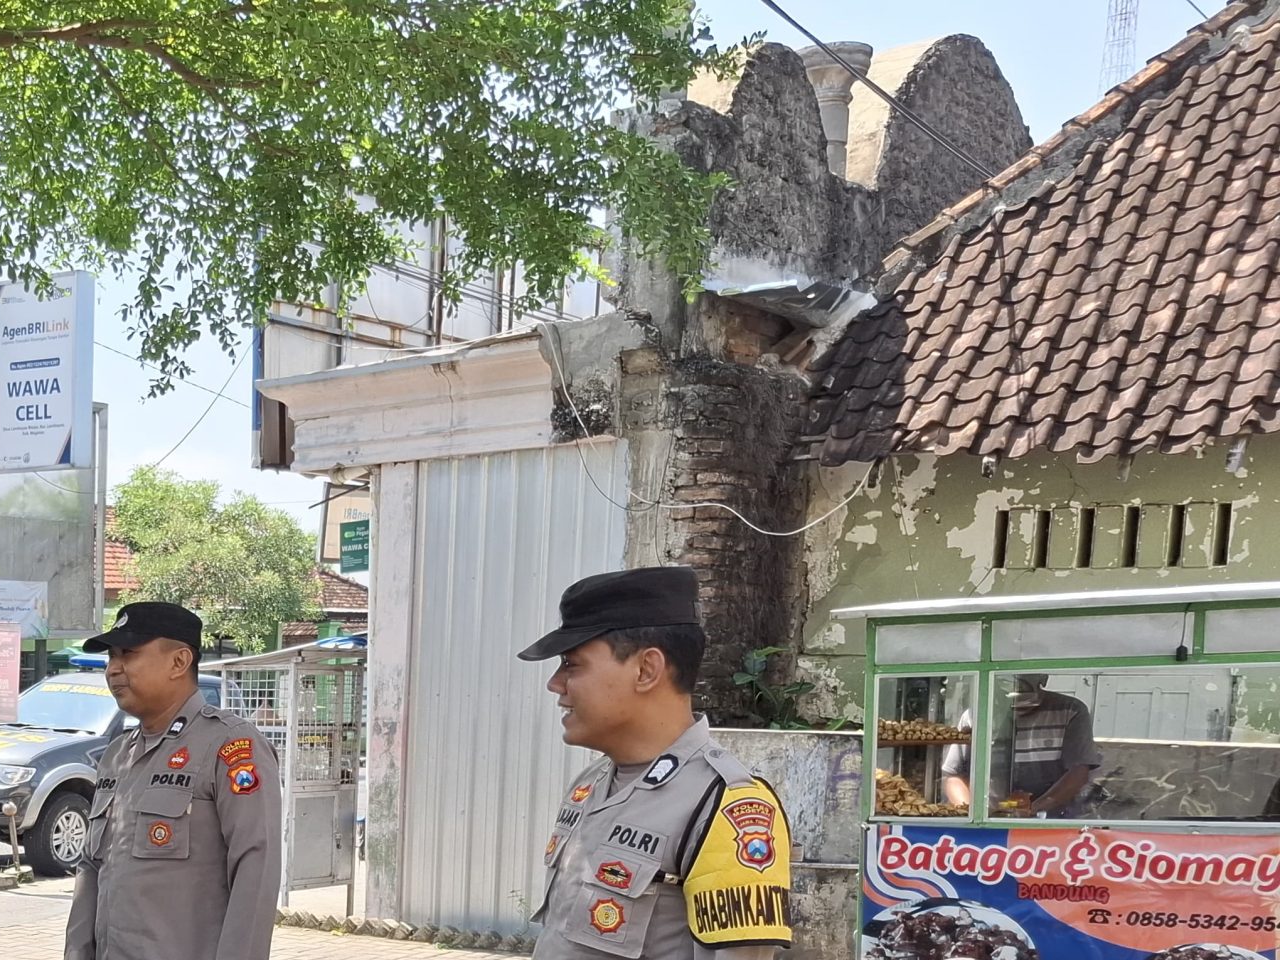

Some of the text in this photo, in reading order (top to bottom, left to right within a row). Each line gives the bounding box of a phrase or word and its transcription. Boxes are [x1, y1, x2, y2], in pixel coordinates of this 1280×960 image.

[2, 318, 70, 340] AgenBRILink
[7, 377, 61, 398] WAWA
[15, 403, 52, 421] CELL
[341, 543, 370, 553] WAWA C
[151, 773, 191, 787] POLRI
[733, 803, 770, 813] POLRES
[608, 825, 660, 855] POLRI
[879, 835, 1059, 884] Batagor
[1102, 840, 1280, 893] Siomay
[1017, 882, 1110, 903] BANDUNG
